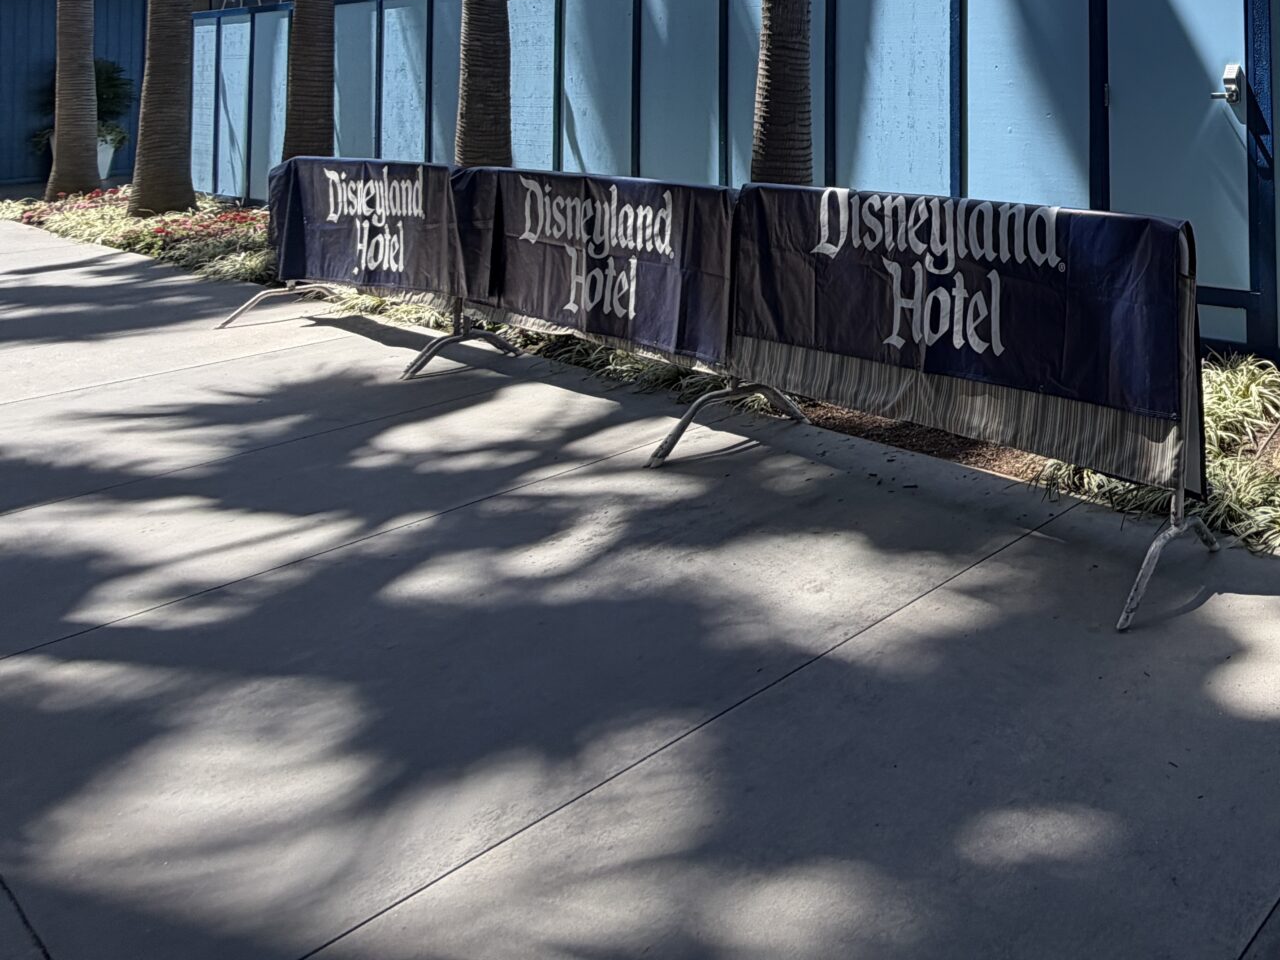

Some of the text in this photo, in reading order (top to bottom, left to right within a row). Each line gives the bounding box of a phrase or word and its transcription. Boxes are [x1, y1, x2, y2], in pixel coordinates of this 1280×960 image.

[323, 165, 423, 228] Disneyland
[519, 175, 673, 259] Disneyland
[352, 218, 404, 275] Hotel
[563, 243, 637, 320] Hotel
[881, 255, 1005, 357] Hotel
